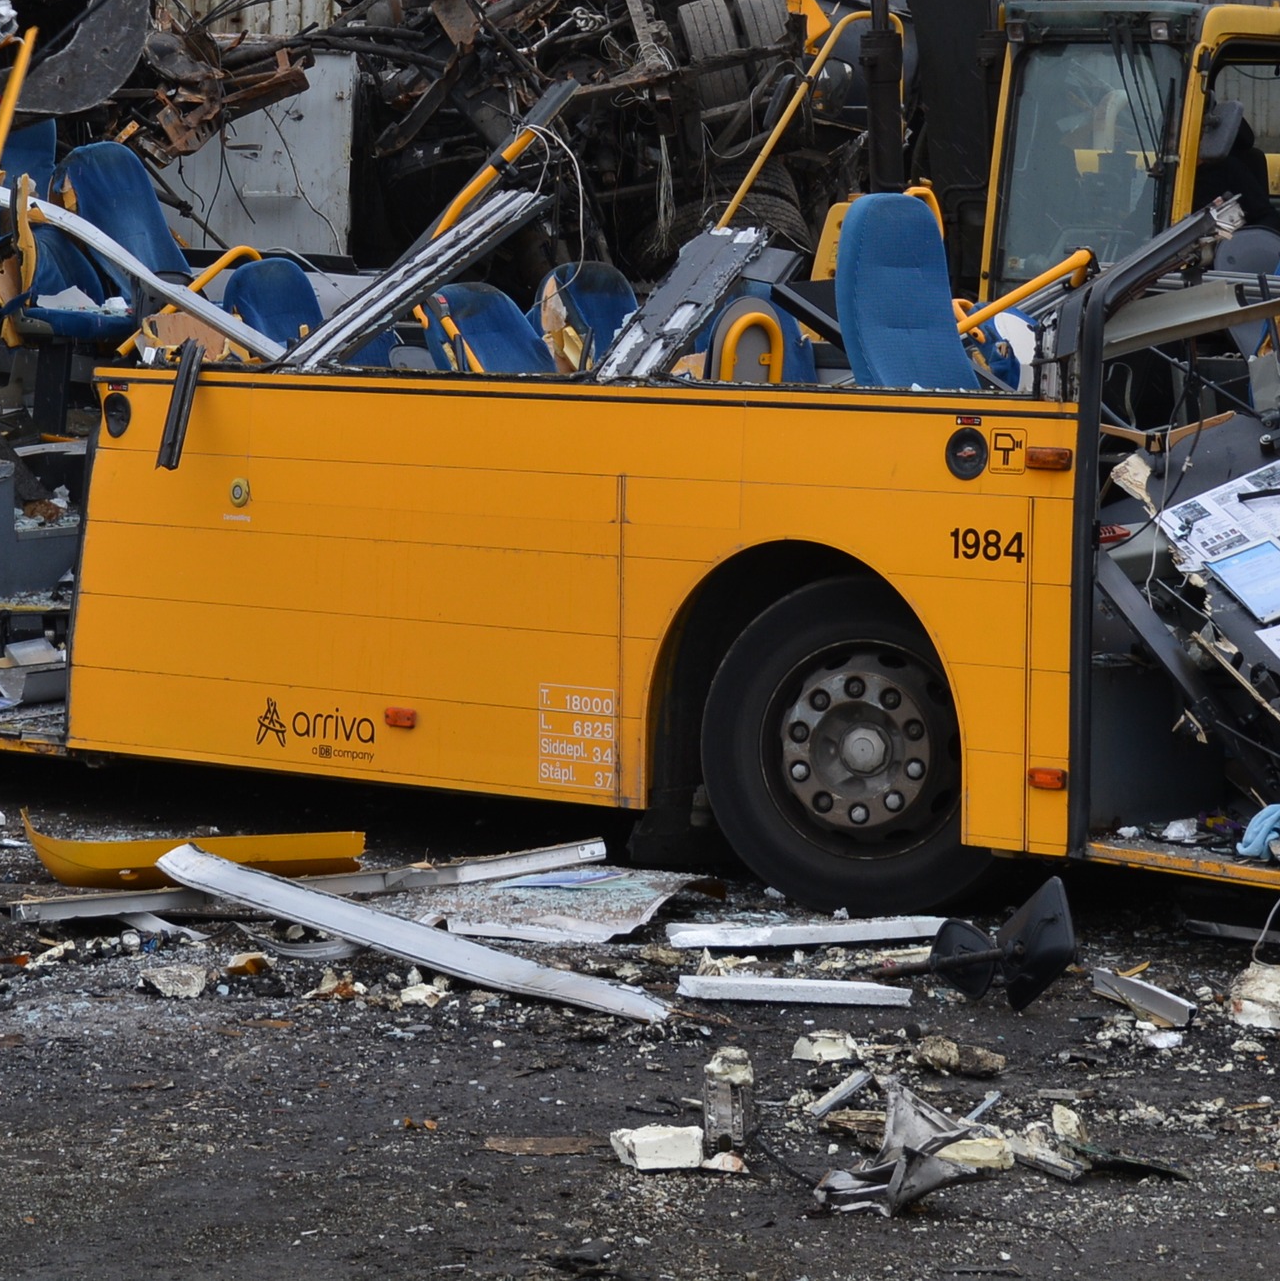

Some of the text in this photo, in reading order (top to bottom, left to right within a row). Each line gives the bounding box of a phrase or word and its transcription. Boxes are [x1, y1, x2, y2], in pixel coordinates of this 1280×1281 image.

[950, 527, 1025, 563] 1984
[565, 693, 613, 714] 18000
[292, 706, 375, 744] arriva
[573, 720, 613, 739] 6825
[333, 748, 375, 763] company
[540, 737, 612, 764] Siddepl. 34
[540, 761, 613, 788] Ståpl. 37
